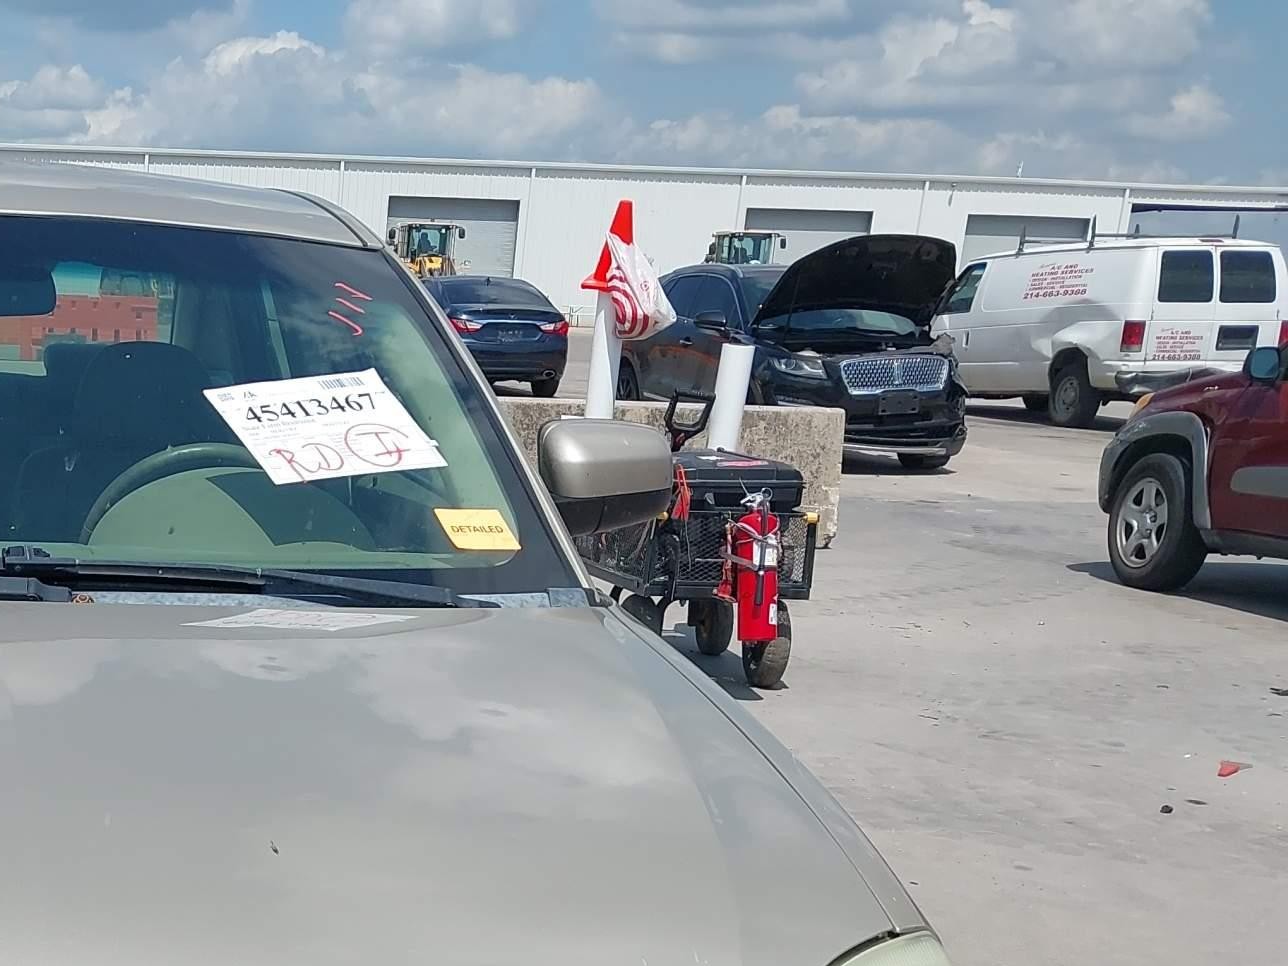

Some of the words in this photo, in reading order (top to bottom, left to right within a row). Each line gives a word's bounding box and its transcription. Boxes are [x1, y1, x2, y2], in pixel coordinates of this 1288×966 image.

[1031, 270, 1059, 278] HEATING
[1060, 268, 1094, 276] SERVICES
[246, 393, 376, 423] 45413467
[450, 525, 505, 534] DETAILED
